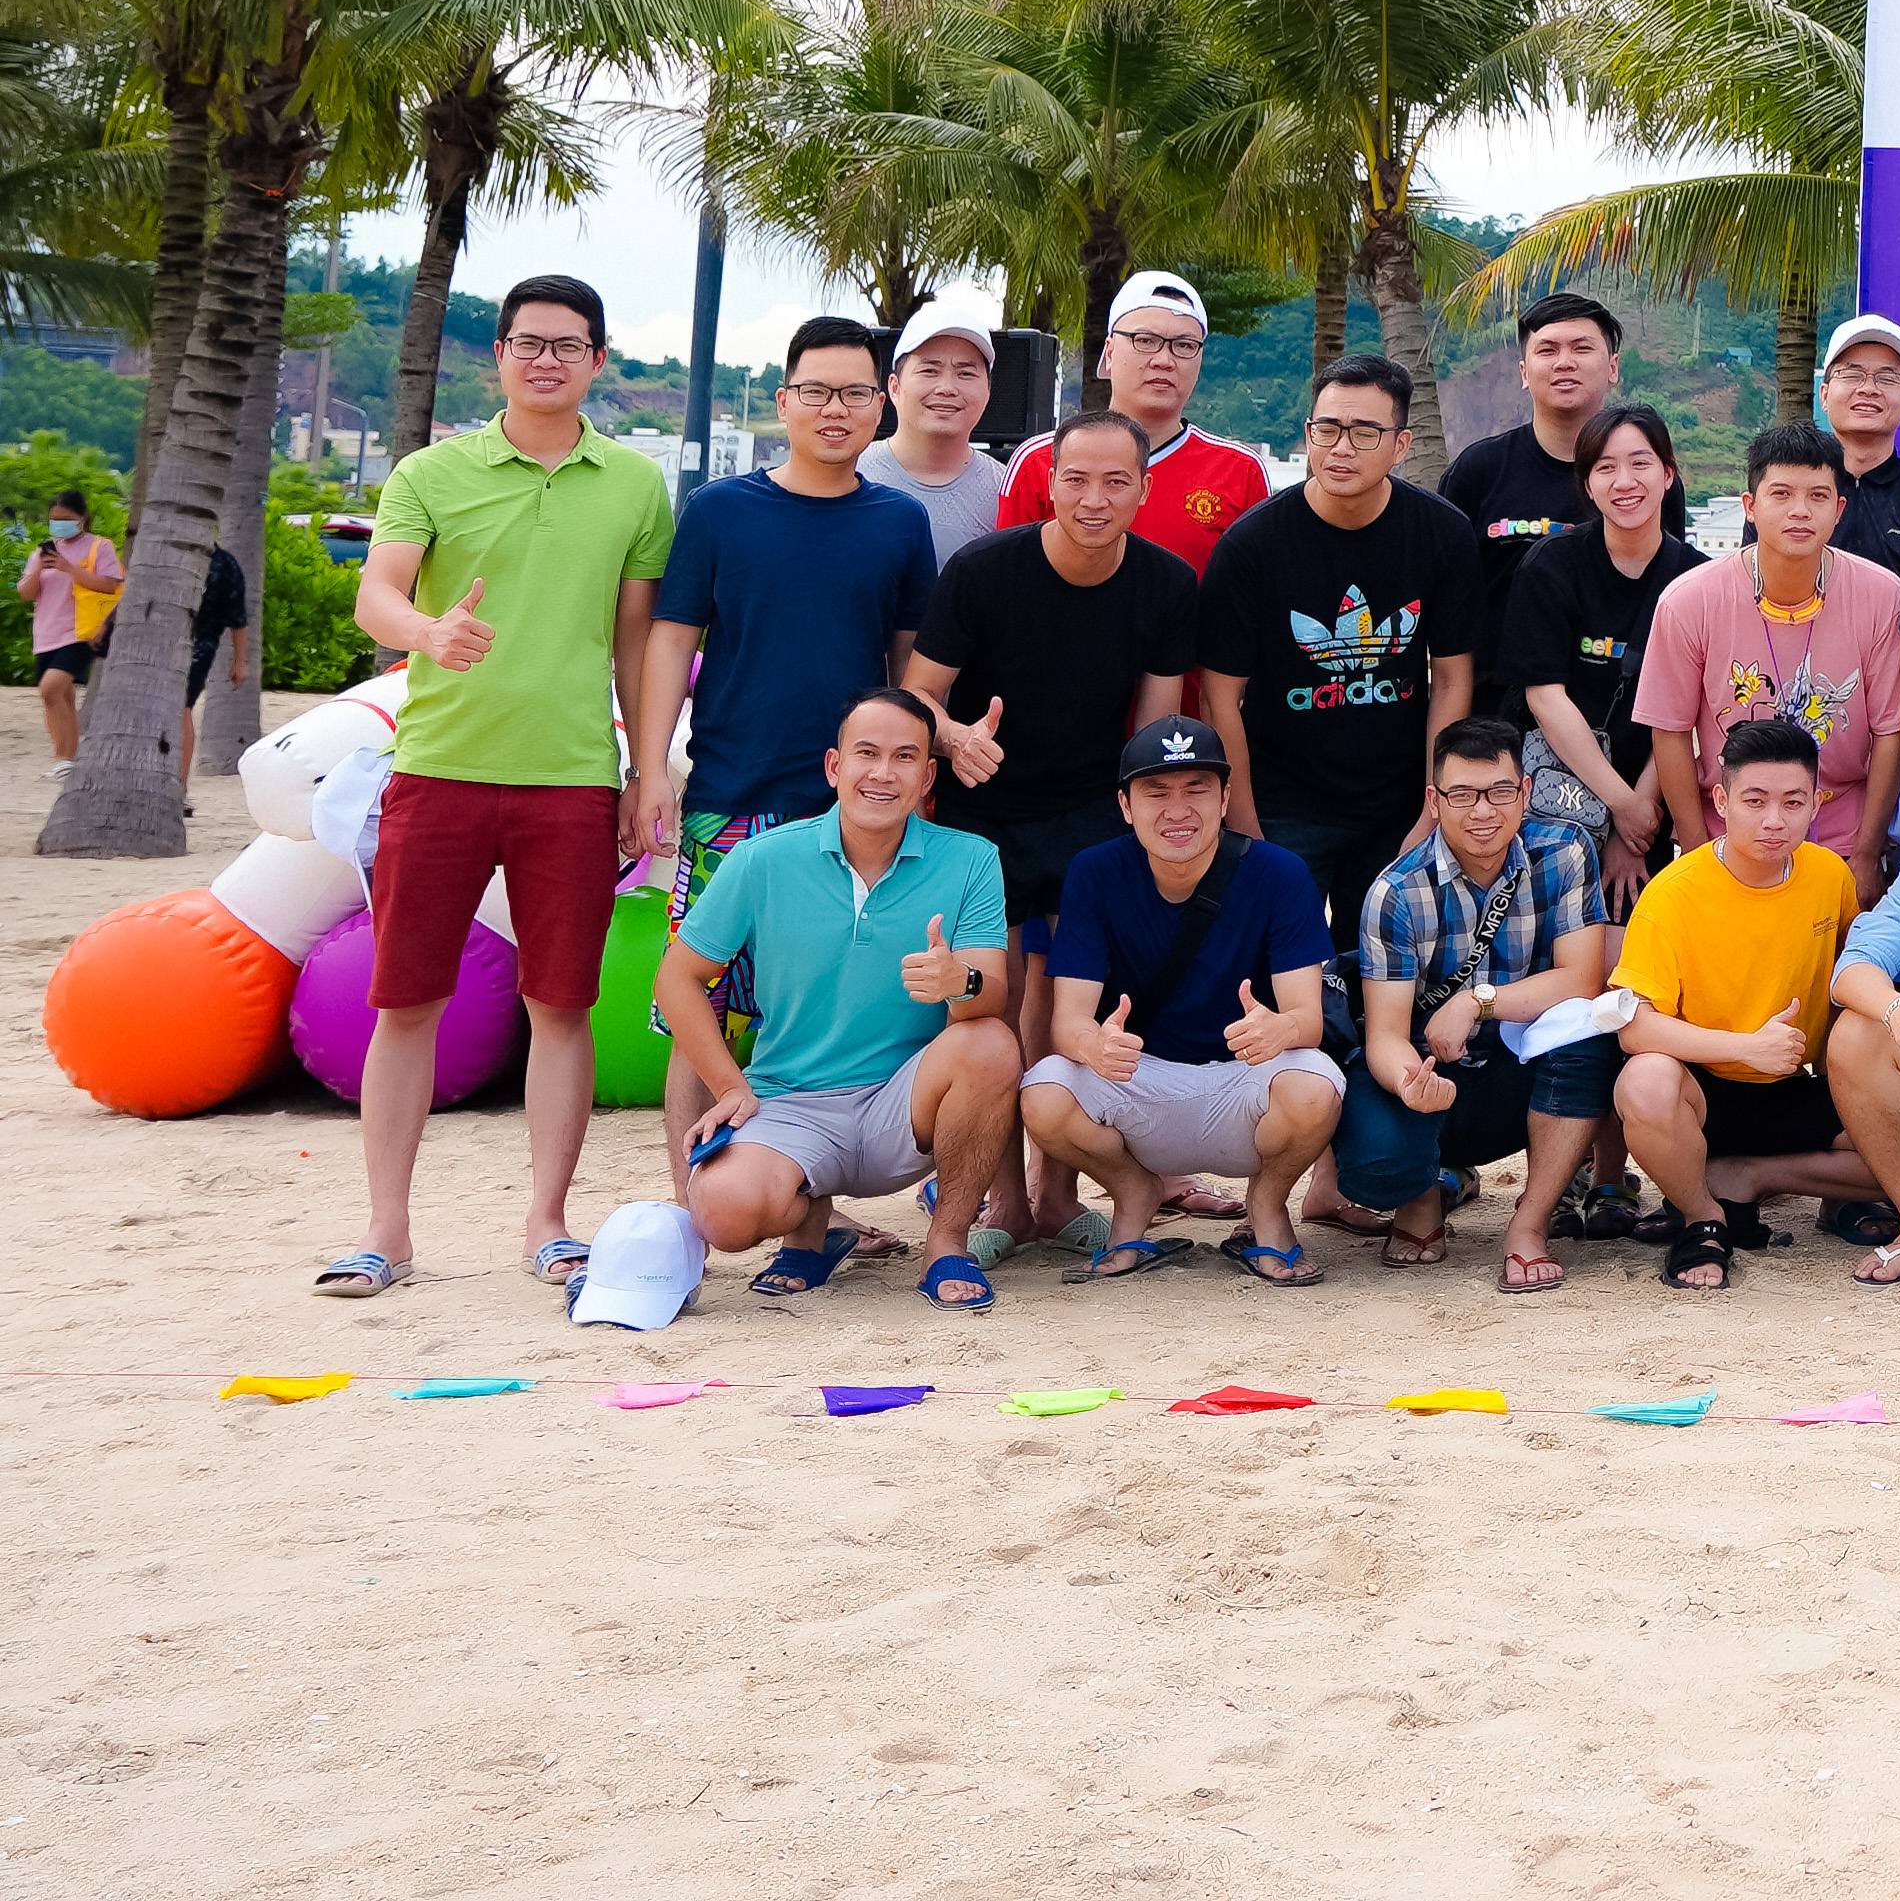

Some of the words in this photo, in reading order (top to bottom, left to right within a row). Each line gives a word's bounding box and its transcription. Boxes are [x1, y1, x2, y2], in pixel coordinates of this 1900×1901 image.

[1287, 673, 1415, 711] adidas
[1163, 751, 1196, 762] adidas
[1415, 983, 1451, 1011] FIND
[1447, 941, 1490, 983] YOUR
[1480, 879, 1517, 939] MAGIC
[636, 1274, 674, 1282] viptrip
